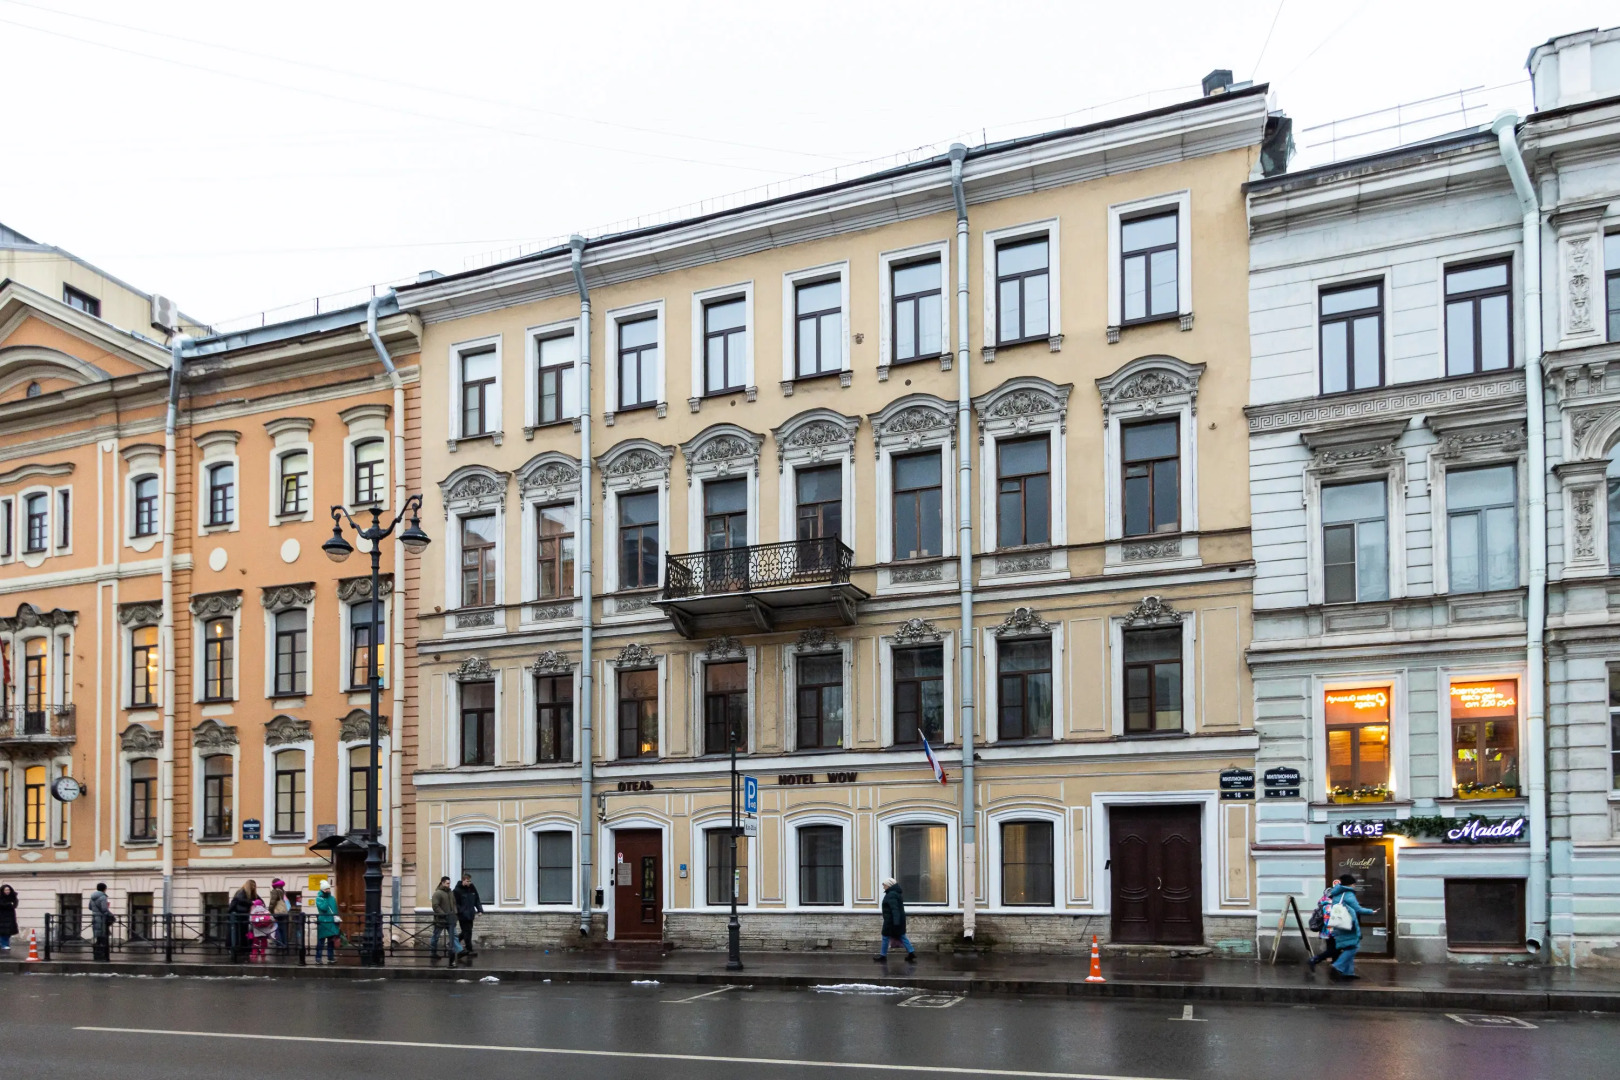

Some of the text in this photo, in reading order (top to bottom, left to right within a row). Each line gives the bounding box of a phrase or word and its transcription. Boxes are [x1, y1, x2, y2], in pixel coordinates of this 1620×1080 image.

[778, 772, 857, 785] HOTEL WOW
[617, 780, 654, 792] ОТЕЛЬ
